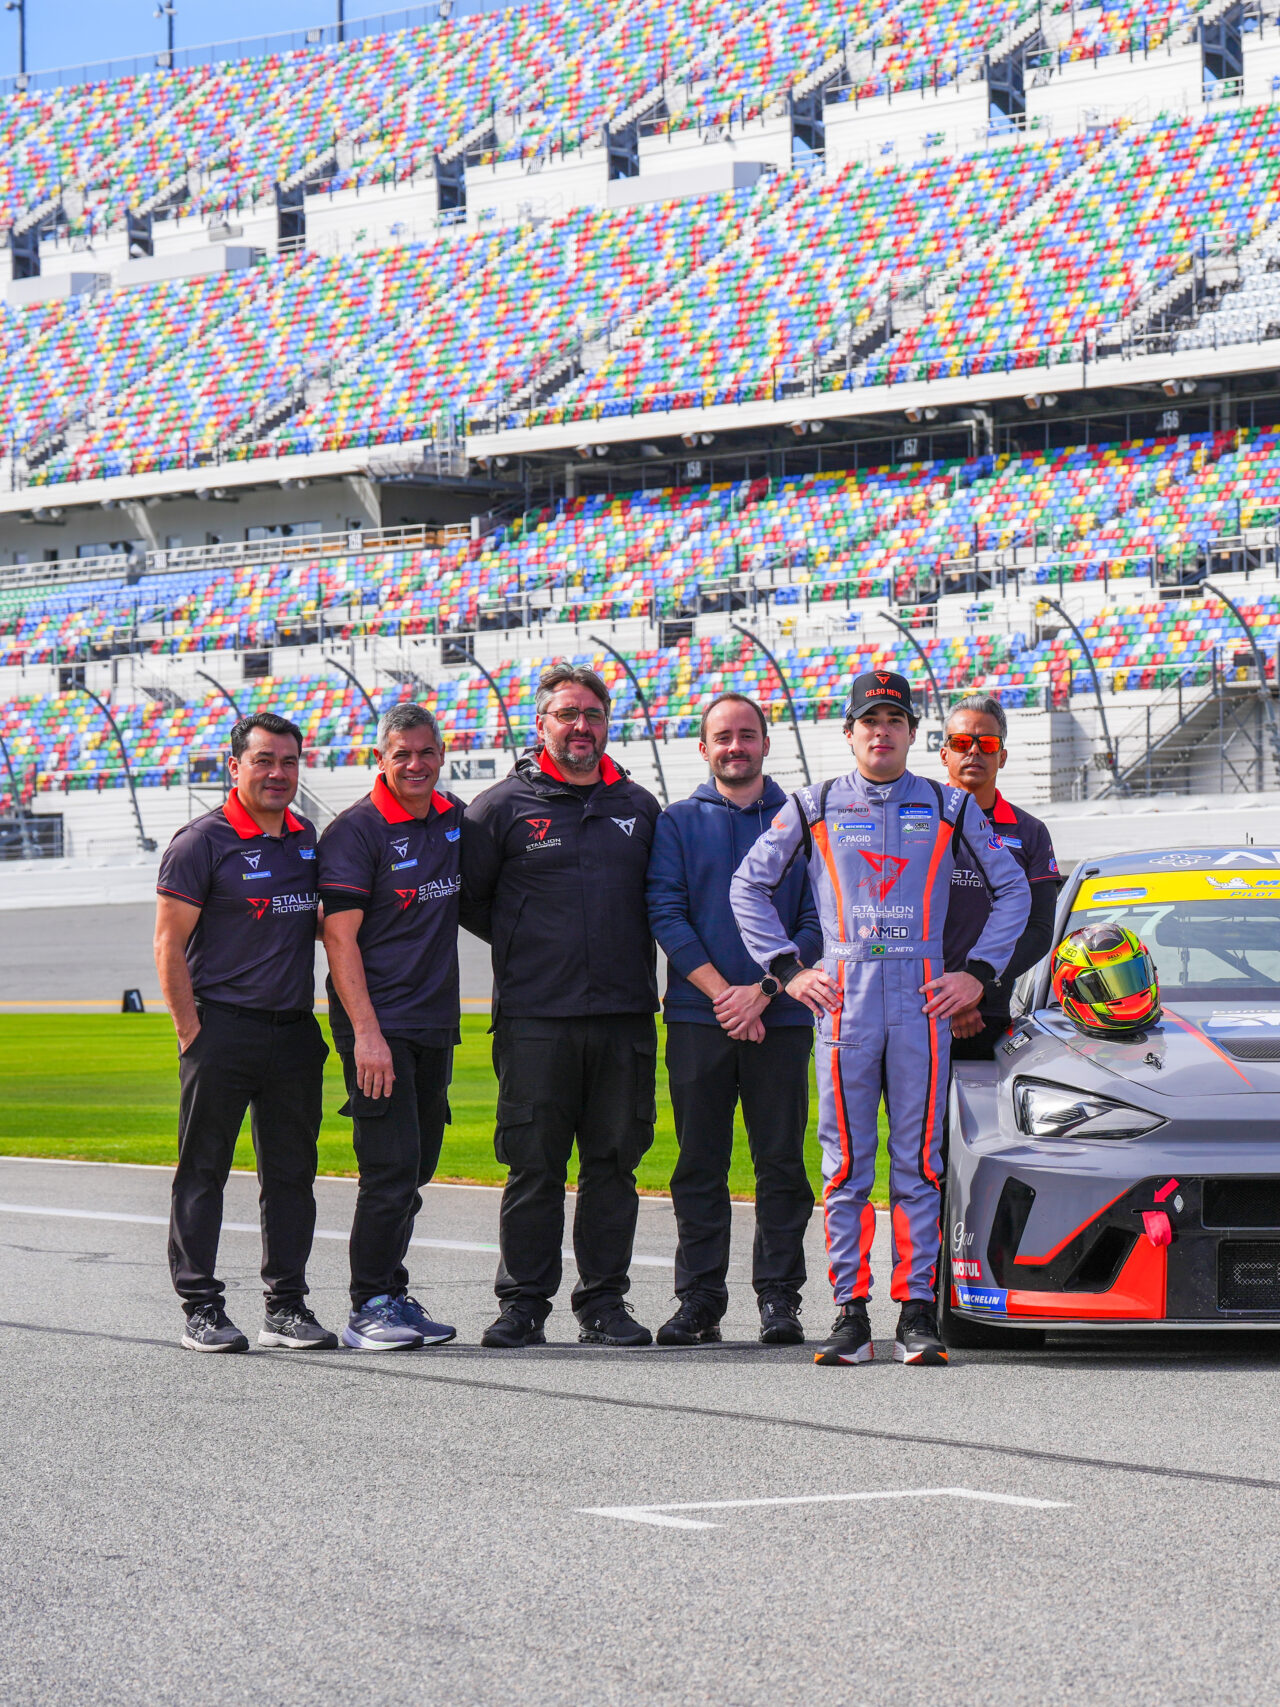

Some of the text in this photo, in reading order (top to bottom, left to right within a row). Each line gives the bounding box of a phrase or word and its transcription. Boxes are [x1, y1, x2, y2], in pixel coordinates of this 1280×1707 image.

[1162, 410, 1180, 430] 156
[903, 438, 919, 456] 157
[865, 687, 902, 699] CELSO NETO
[526, 838, 561, 850] STALLION
[846, 835, 871, 843] PAGID
[852, 905, 914, 913] STALLION
[1086, 905, 1175, 936] 77
[870, 925, 909, 938] AMED
[830, 947, 852, 955] HRX
[952, 1260, 980, 1277] MOTUL
[962, 1293, 1000, 1305] MICHELIN
